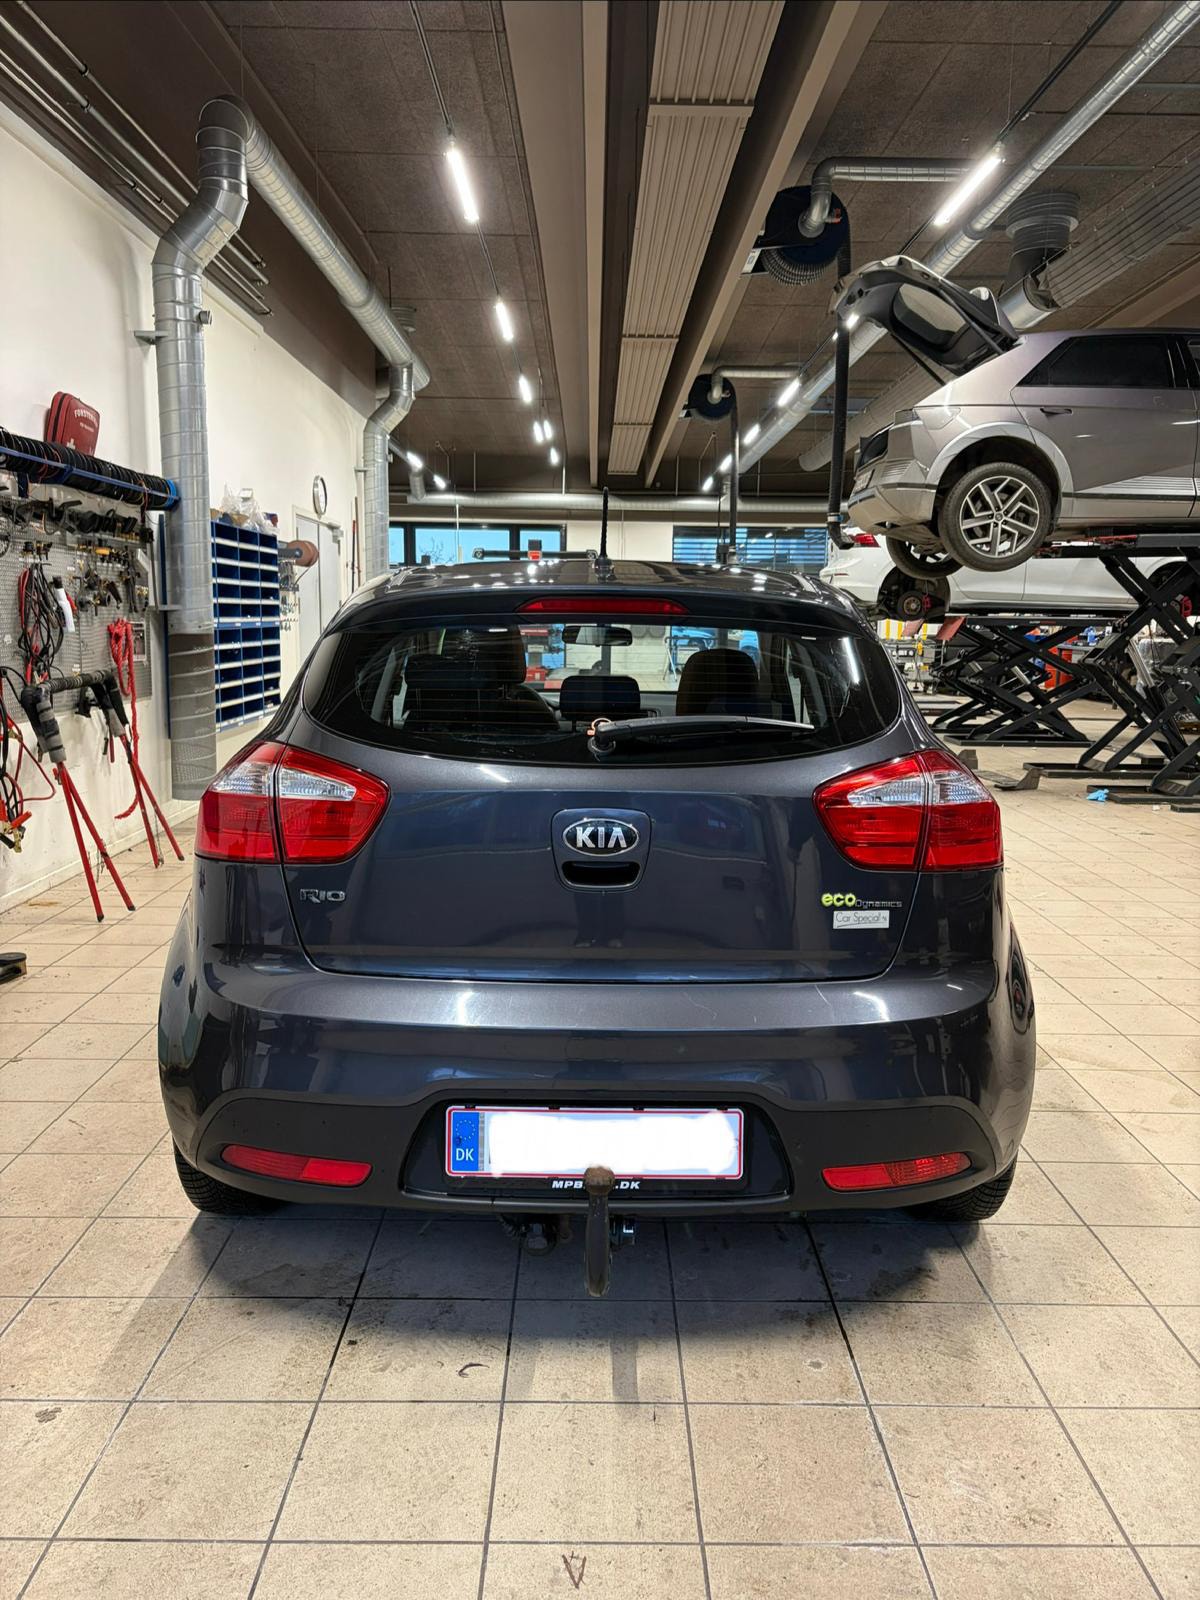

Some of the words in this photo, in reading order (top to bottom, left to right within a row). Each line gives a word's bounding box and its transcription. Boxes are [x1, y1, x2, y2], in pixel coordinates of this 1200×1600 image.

[576, 826, 627, 848] KIA
[300, 888, 345, 903] RIO
[835, 911, 851, 923] Car
[455, 1148, 474, 1162] DK
[551, 1180, 641, 1190] MPB.DK
